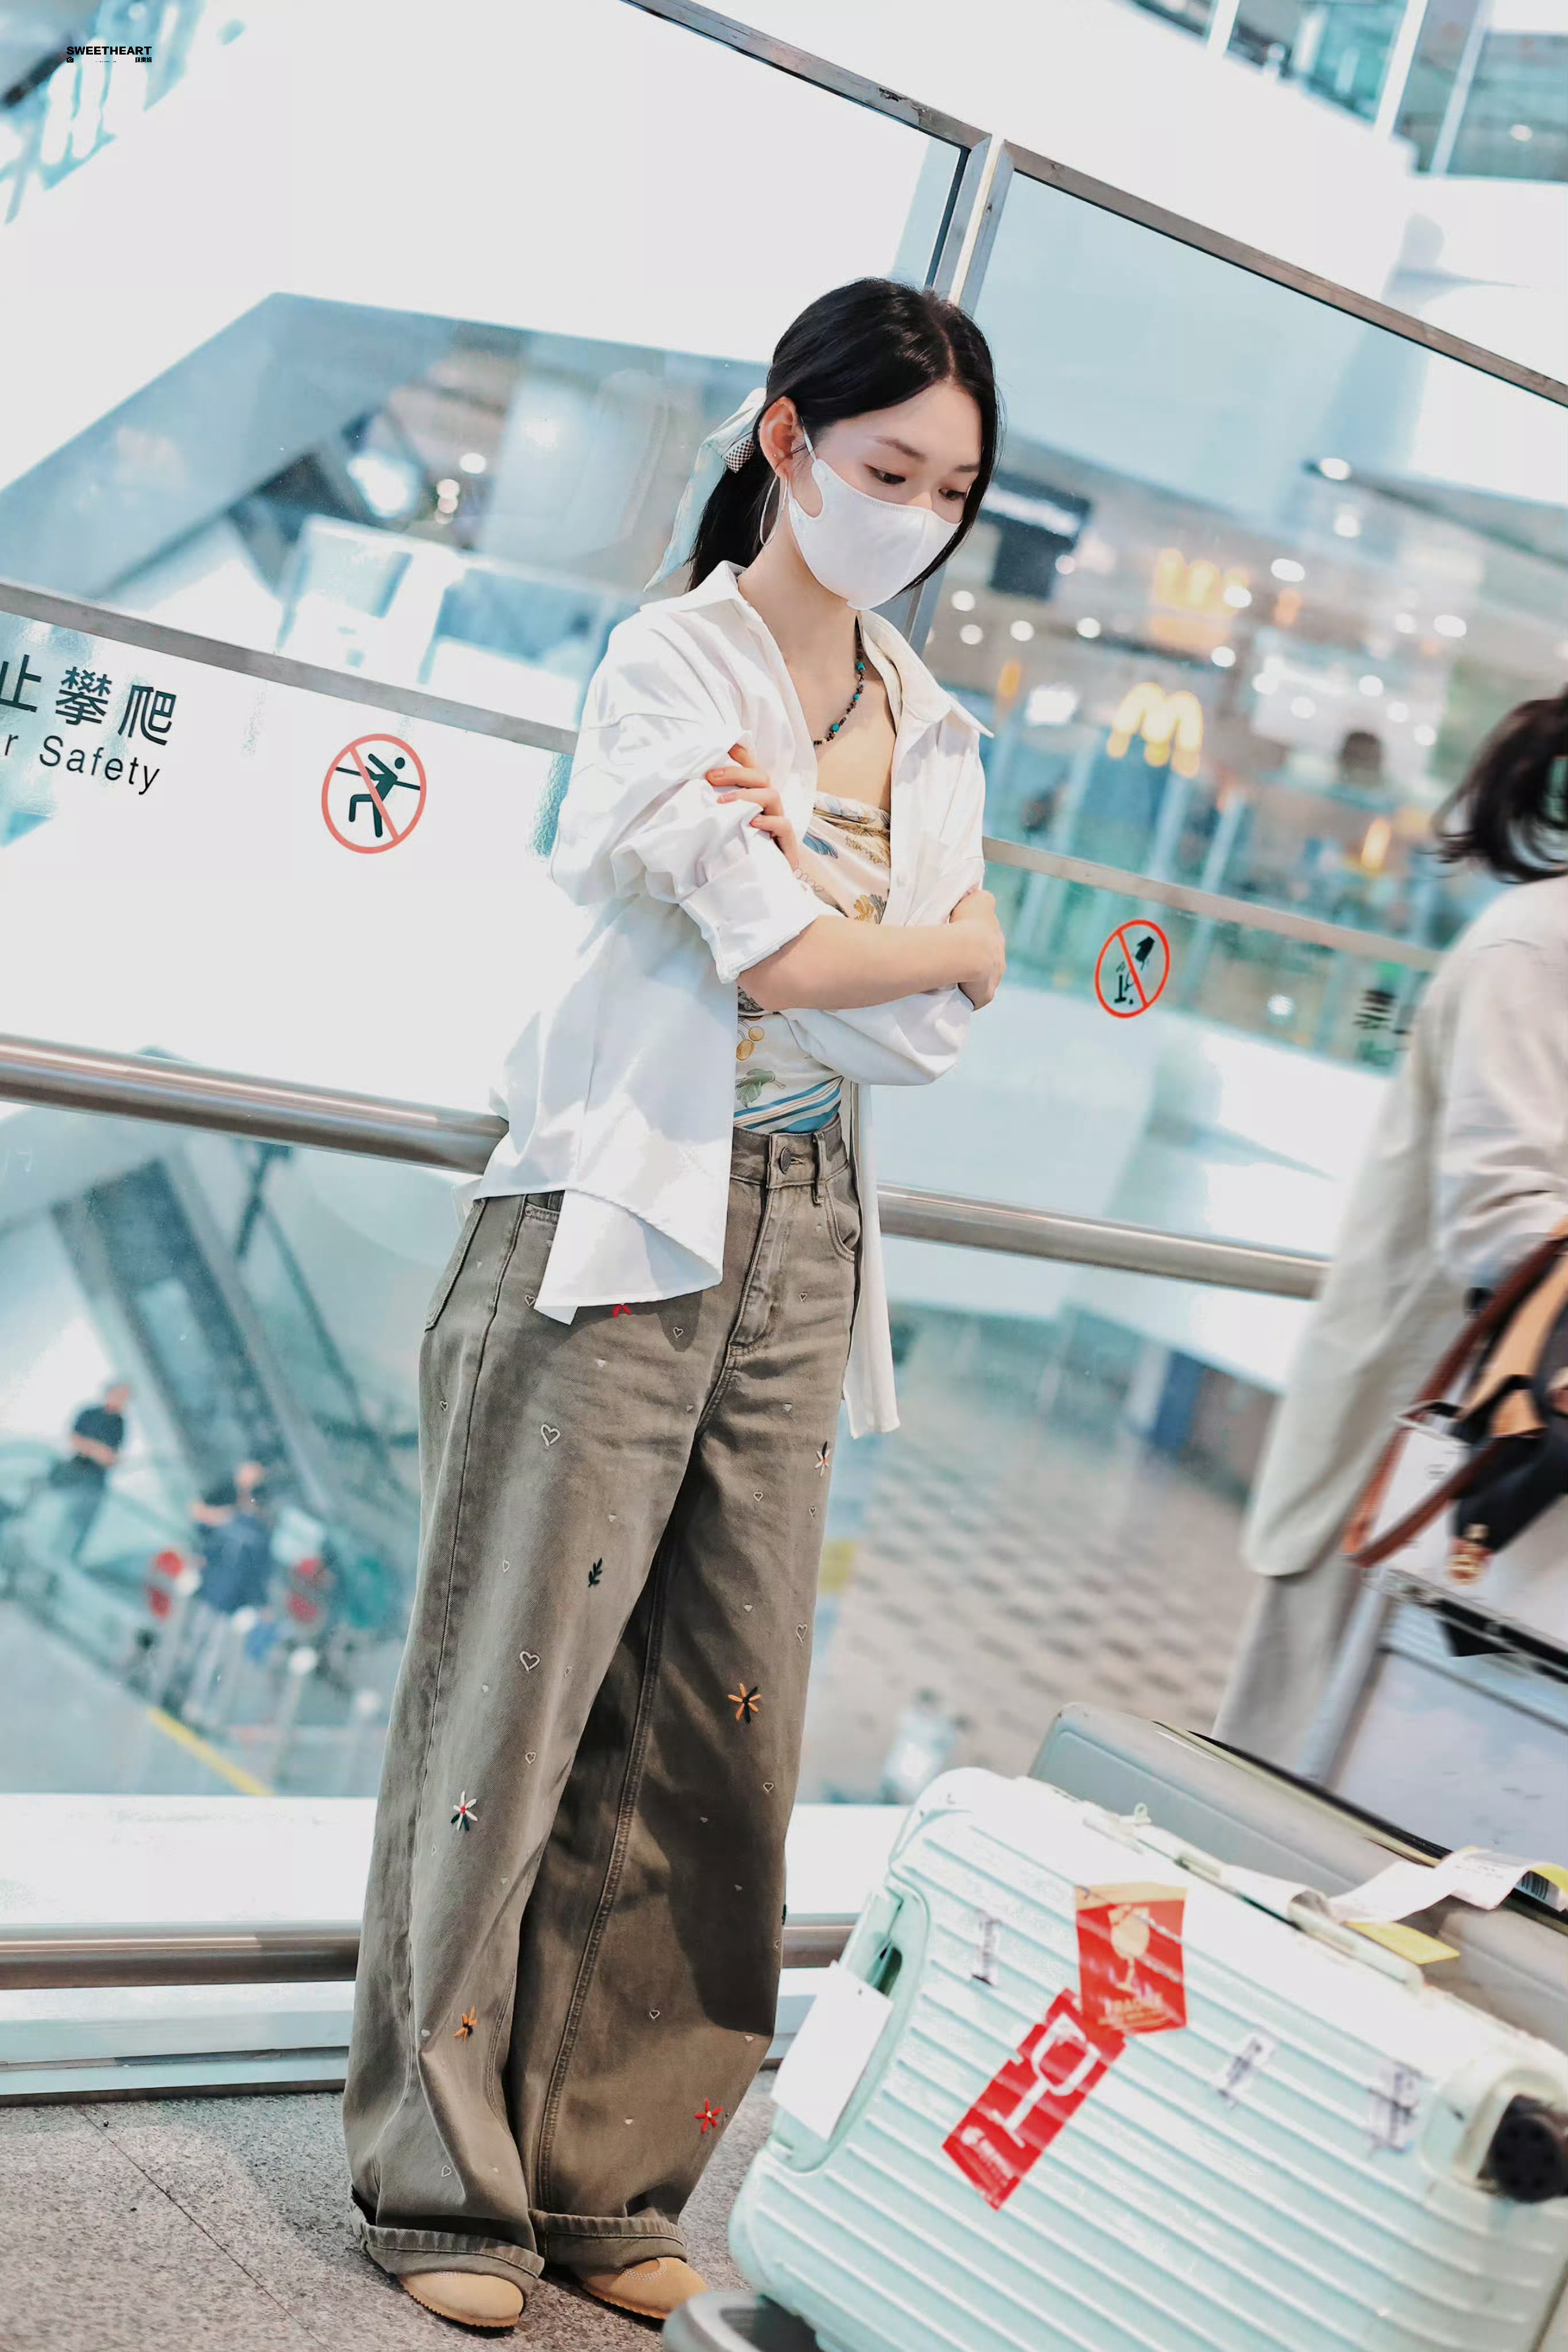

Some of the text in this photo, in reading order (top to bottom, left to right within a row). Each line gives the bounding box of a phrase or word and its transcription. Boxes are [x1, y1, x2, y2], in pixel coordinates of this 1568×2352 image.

[0, 654, 177, 746] 止攀爬
[40, 735, 160, 795] Safety
